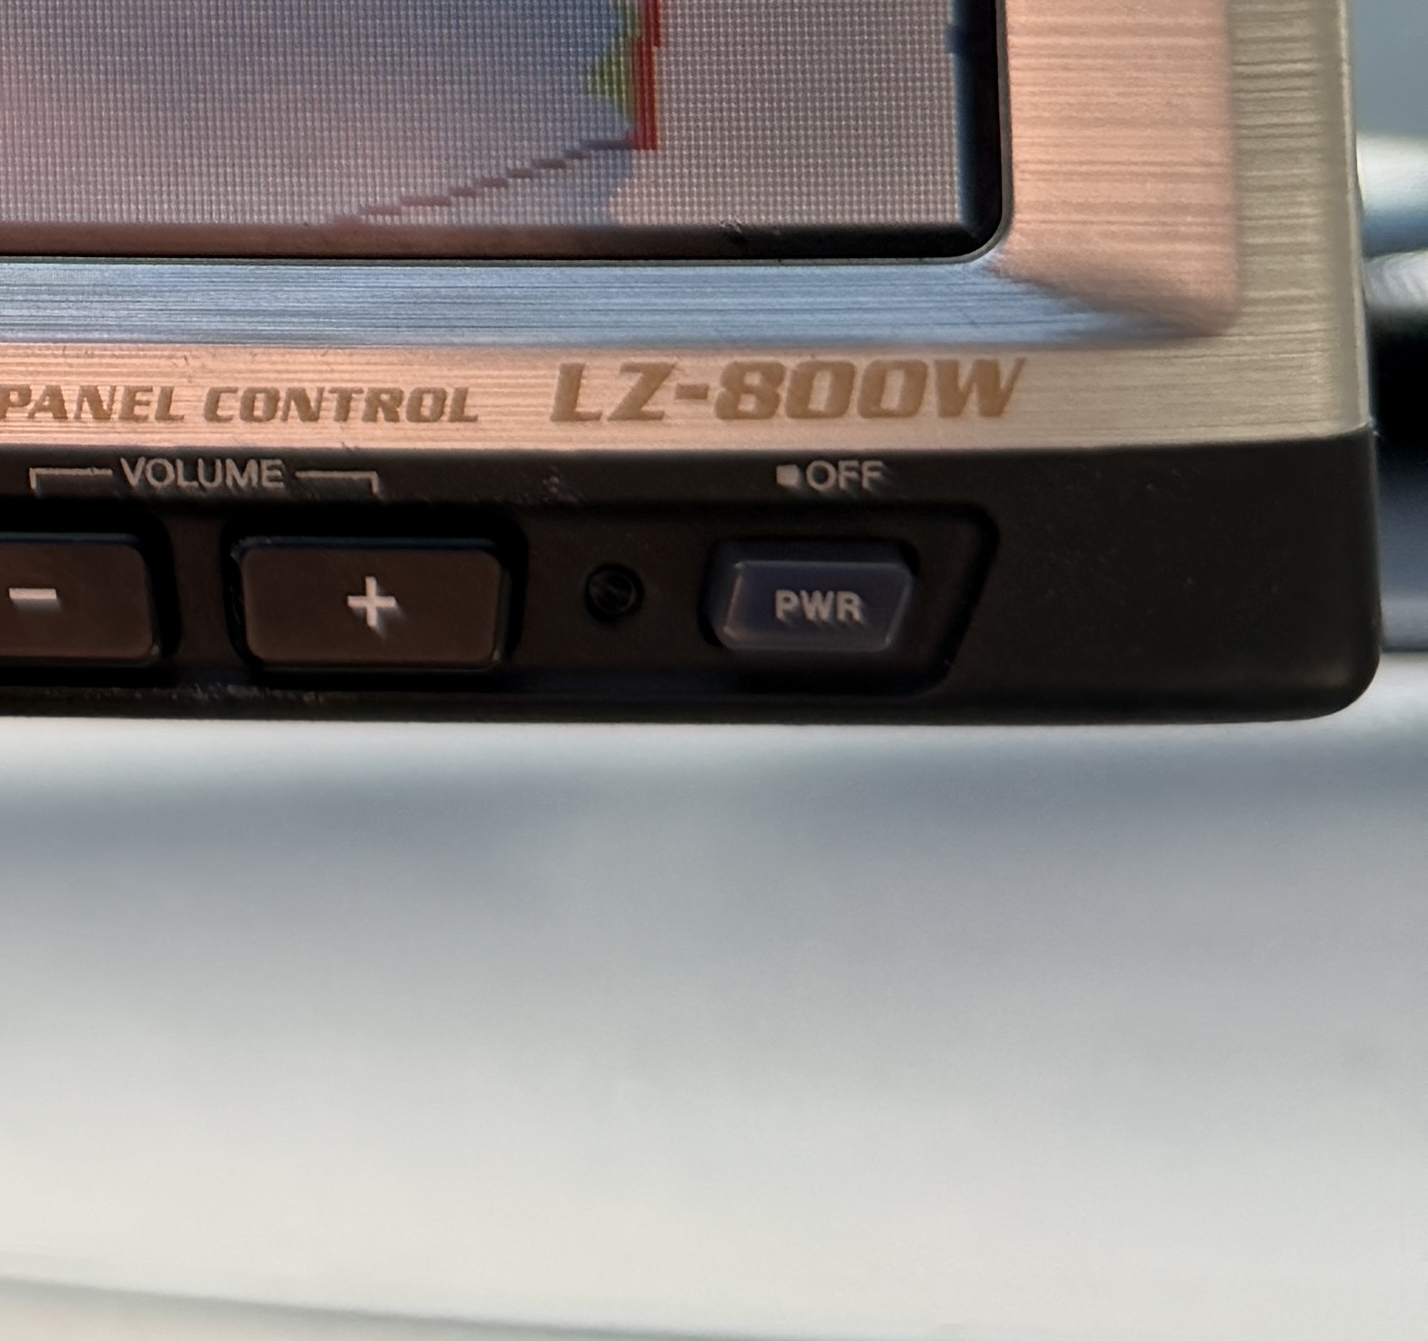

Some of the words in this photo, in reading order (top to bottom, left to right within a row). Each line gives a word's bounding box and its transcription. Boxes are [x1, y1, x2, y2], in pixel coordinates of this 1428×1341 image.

[203, 384, 479, 424] CONTROL
[549, 357, 1027, 423] LZ-800W
[120, 457, 285, 489] VOLUME
[806, 460, 888, 491] OFF
[775, 590, 863, 621] PWR
